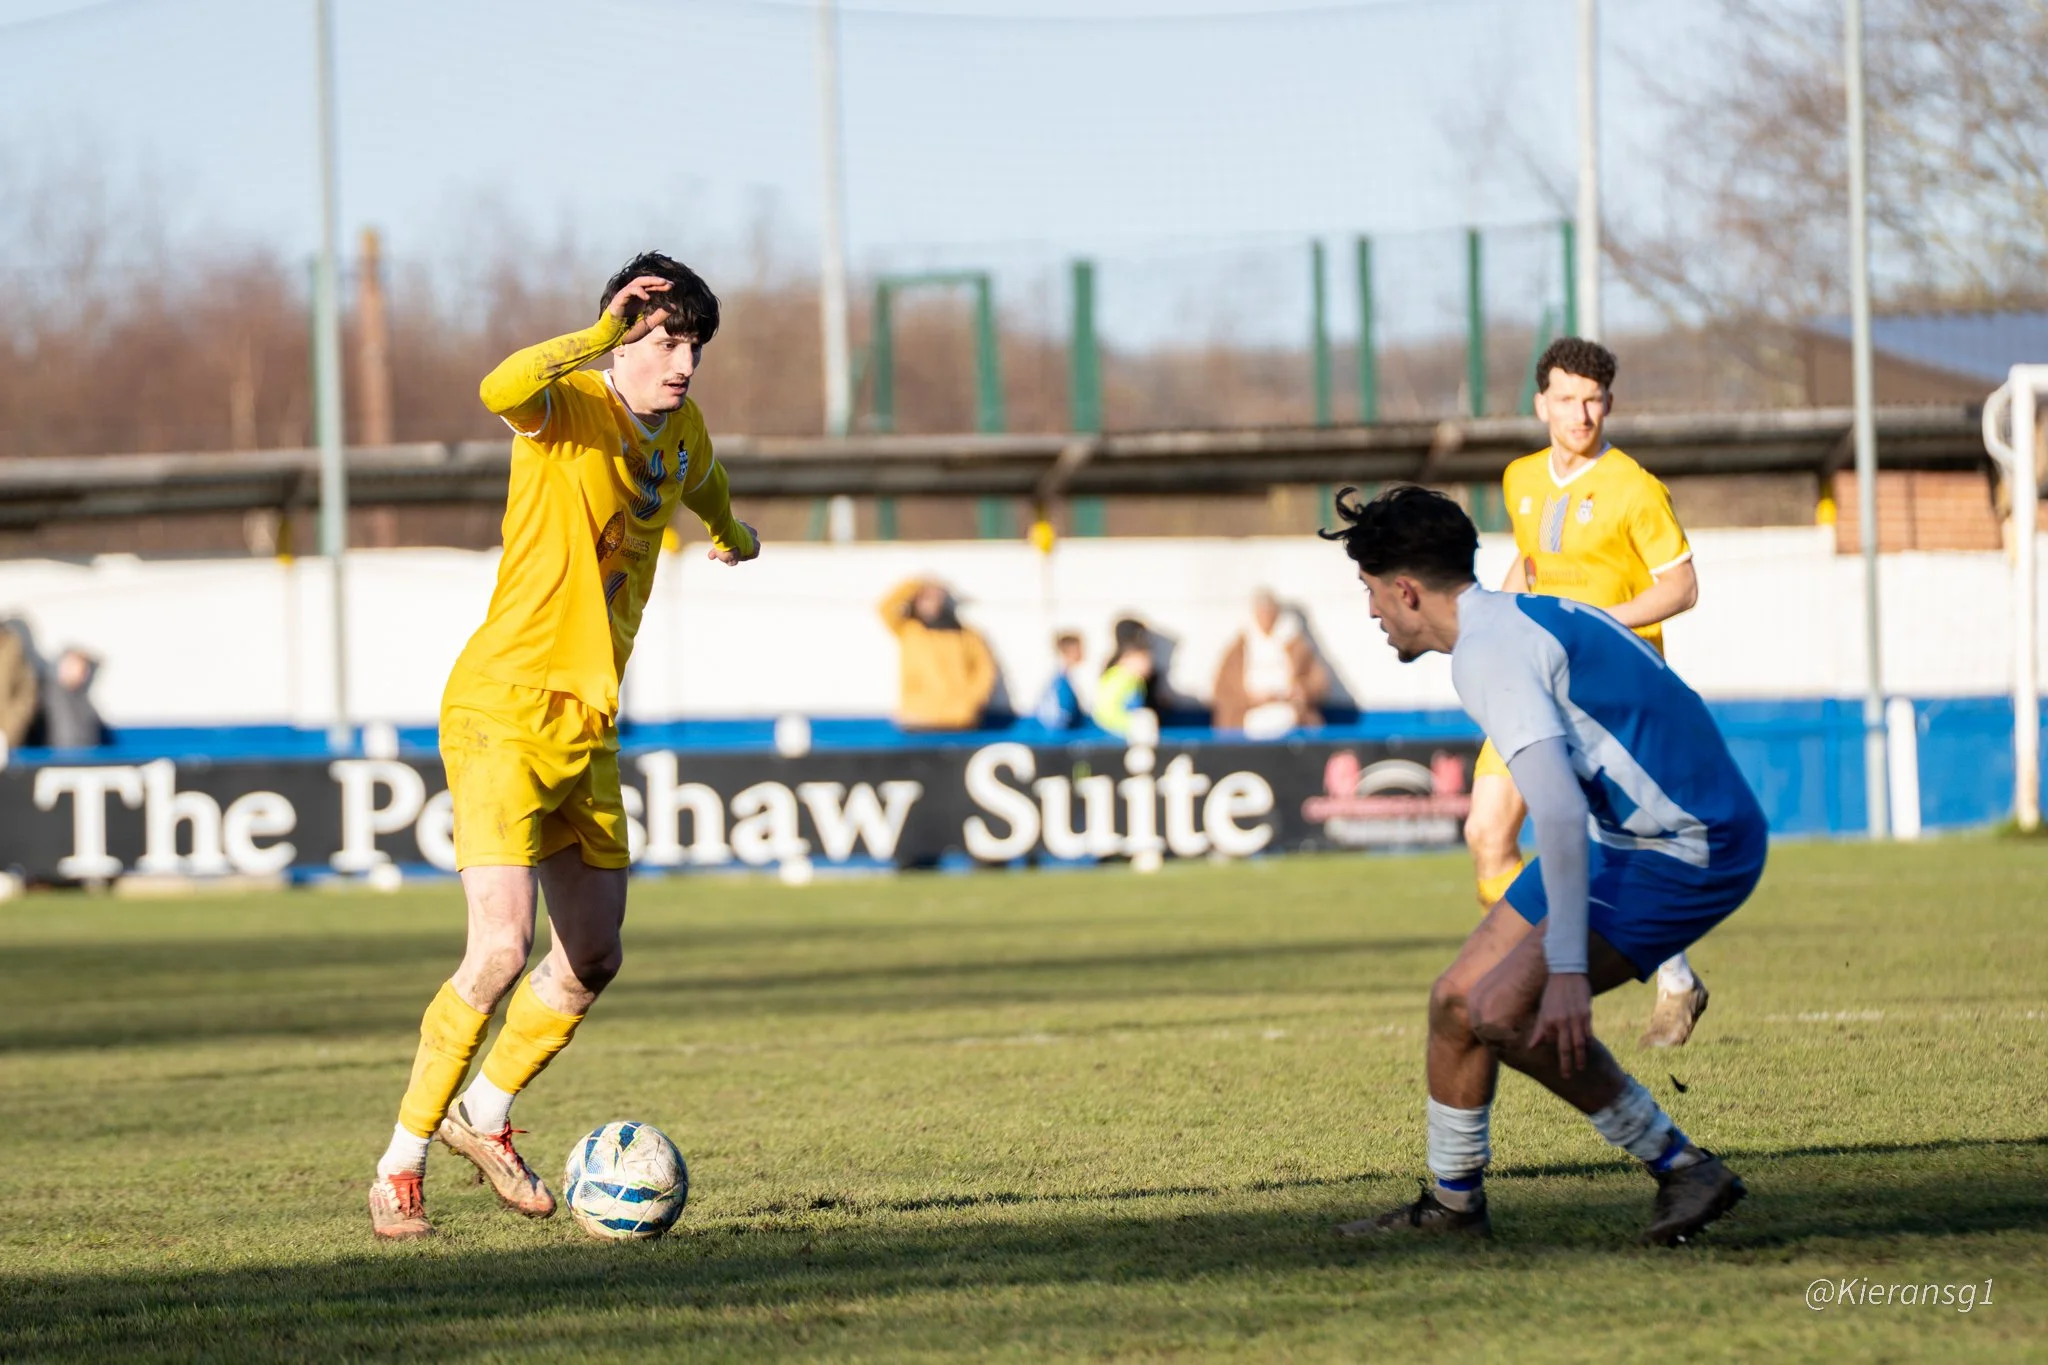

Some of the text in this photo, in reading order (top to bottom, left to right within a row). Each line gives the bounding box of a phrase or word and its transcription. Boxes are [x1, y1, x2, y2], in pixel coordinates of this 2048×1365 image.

[33, 742, 1274, 878] The Pehaw Suite
